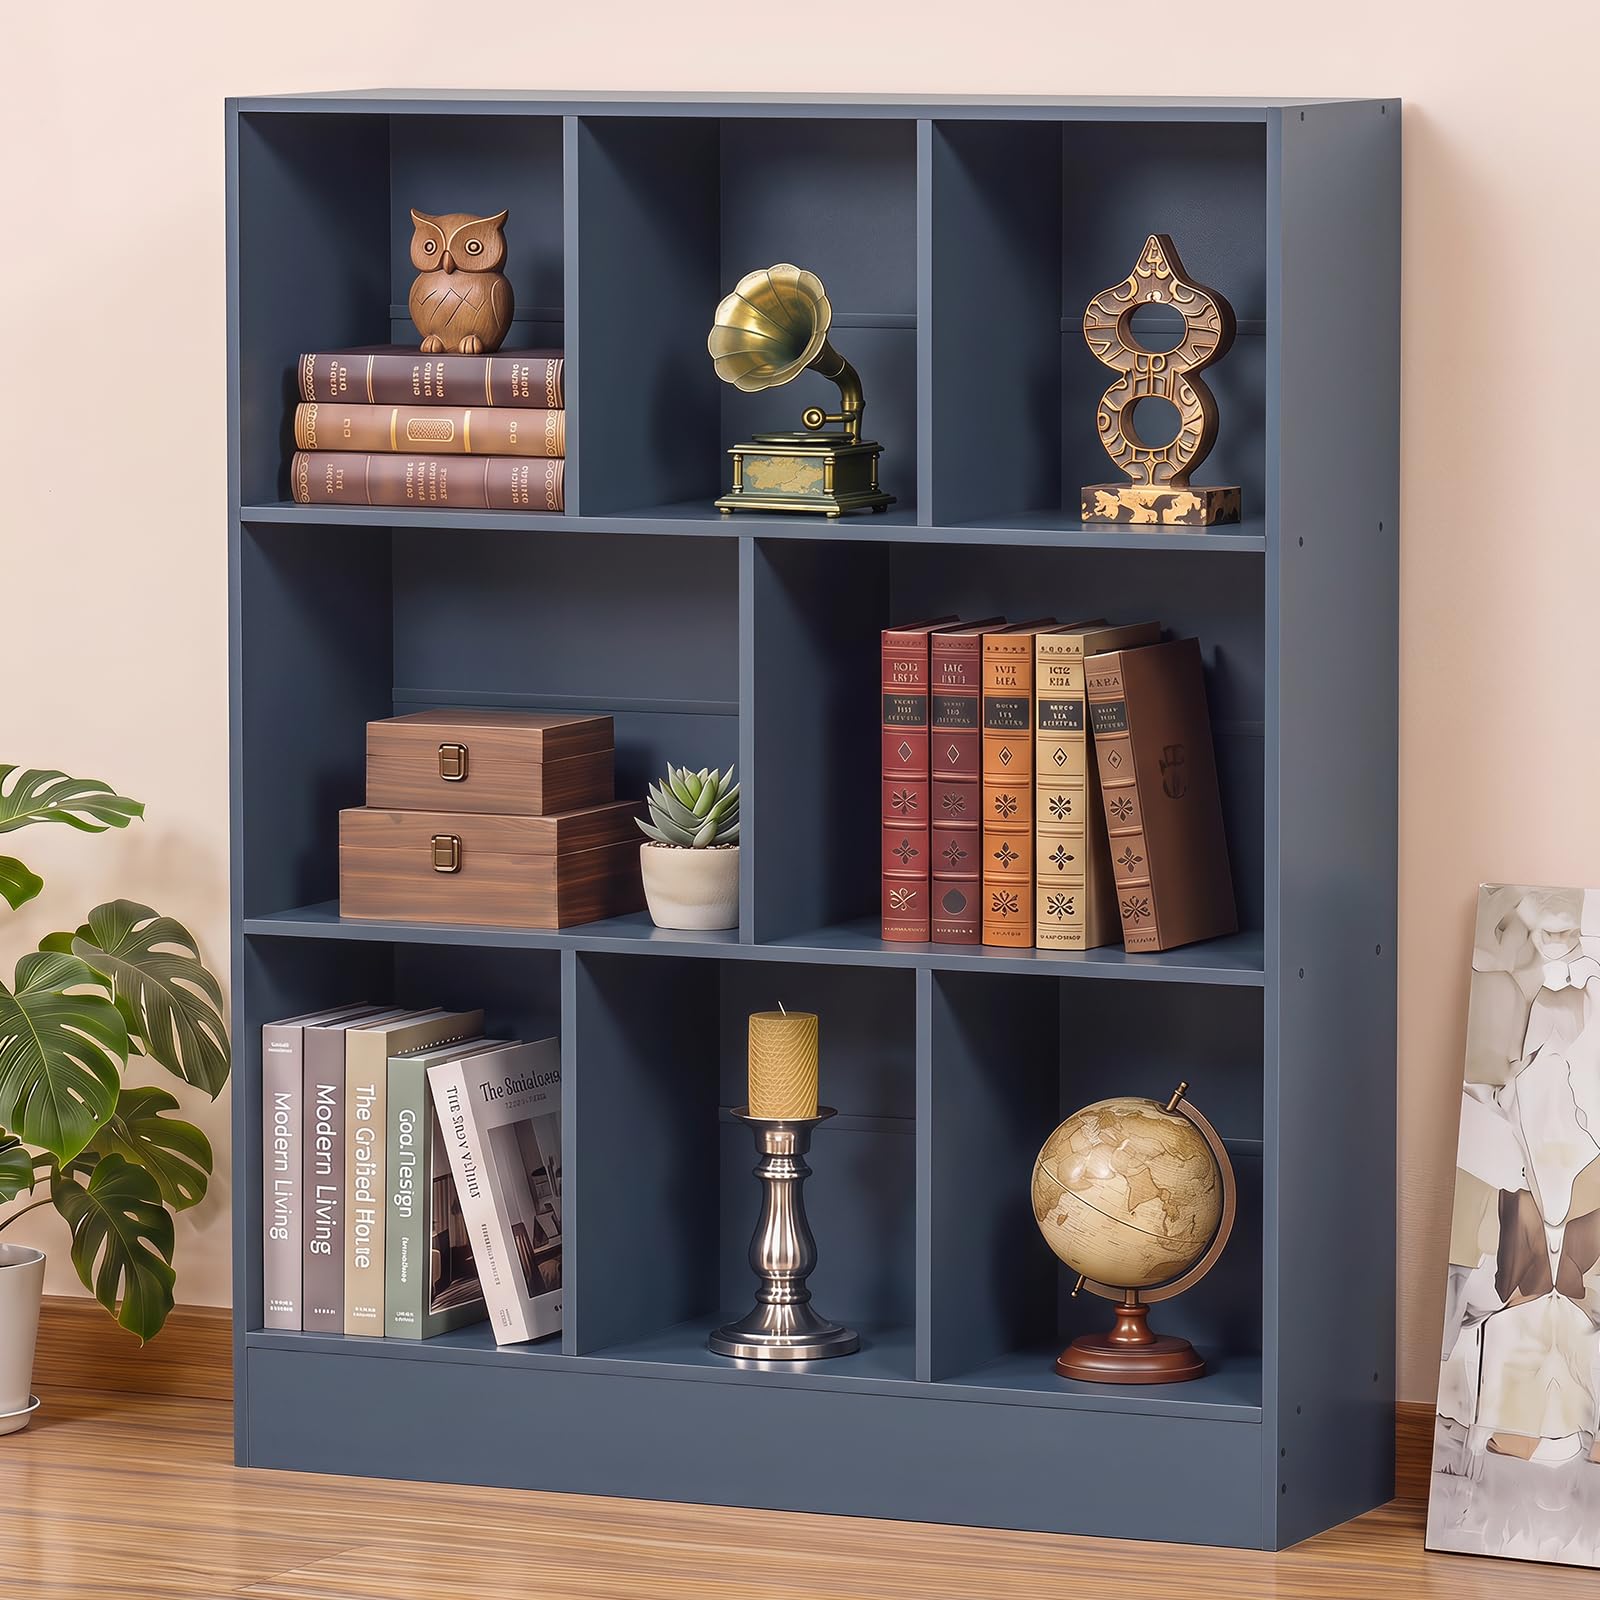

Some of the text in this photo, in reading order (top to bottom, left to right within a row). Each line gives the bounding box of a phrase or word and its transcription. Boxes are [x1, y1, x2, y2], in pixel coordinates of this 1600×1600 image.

[356, 1084, 376, 1121] The
[479, 1080, 504, 1103] The
[269, 1092, 293, 1240] Modern Living
[310, 1084, 337, 1255] Modern Living
